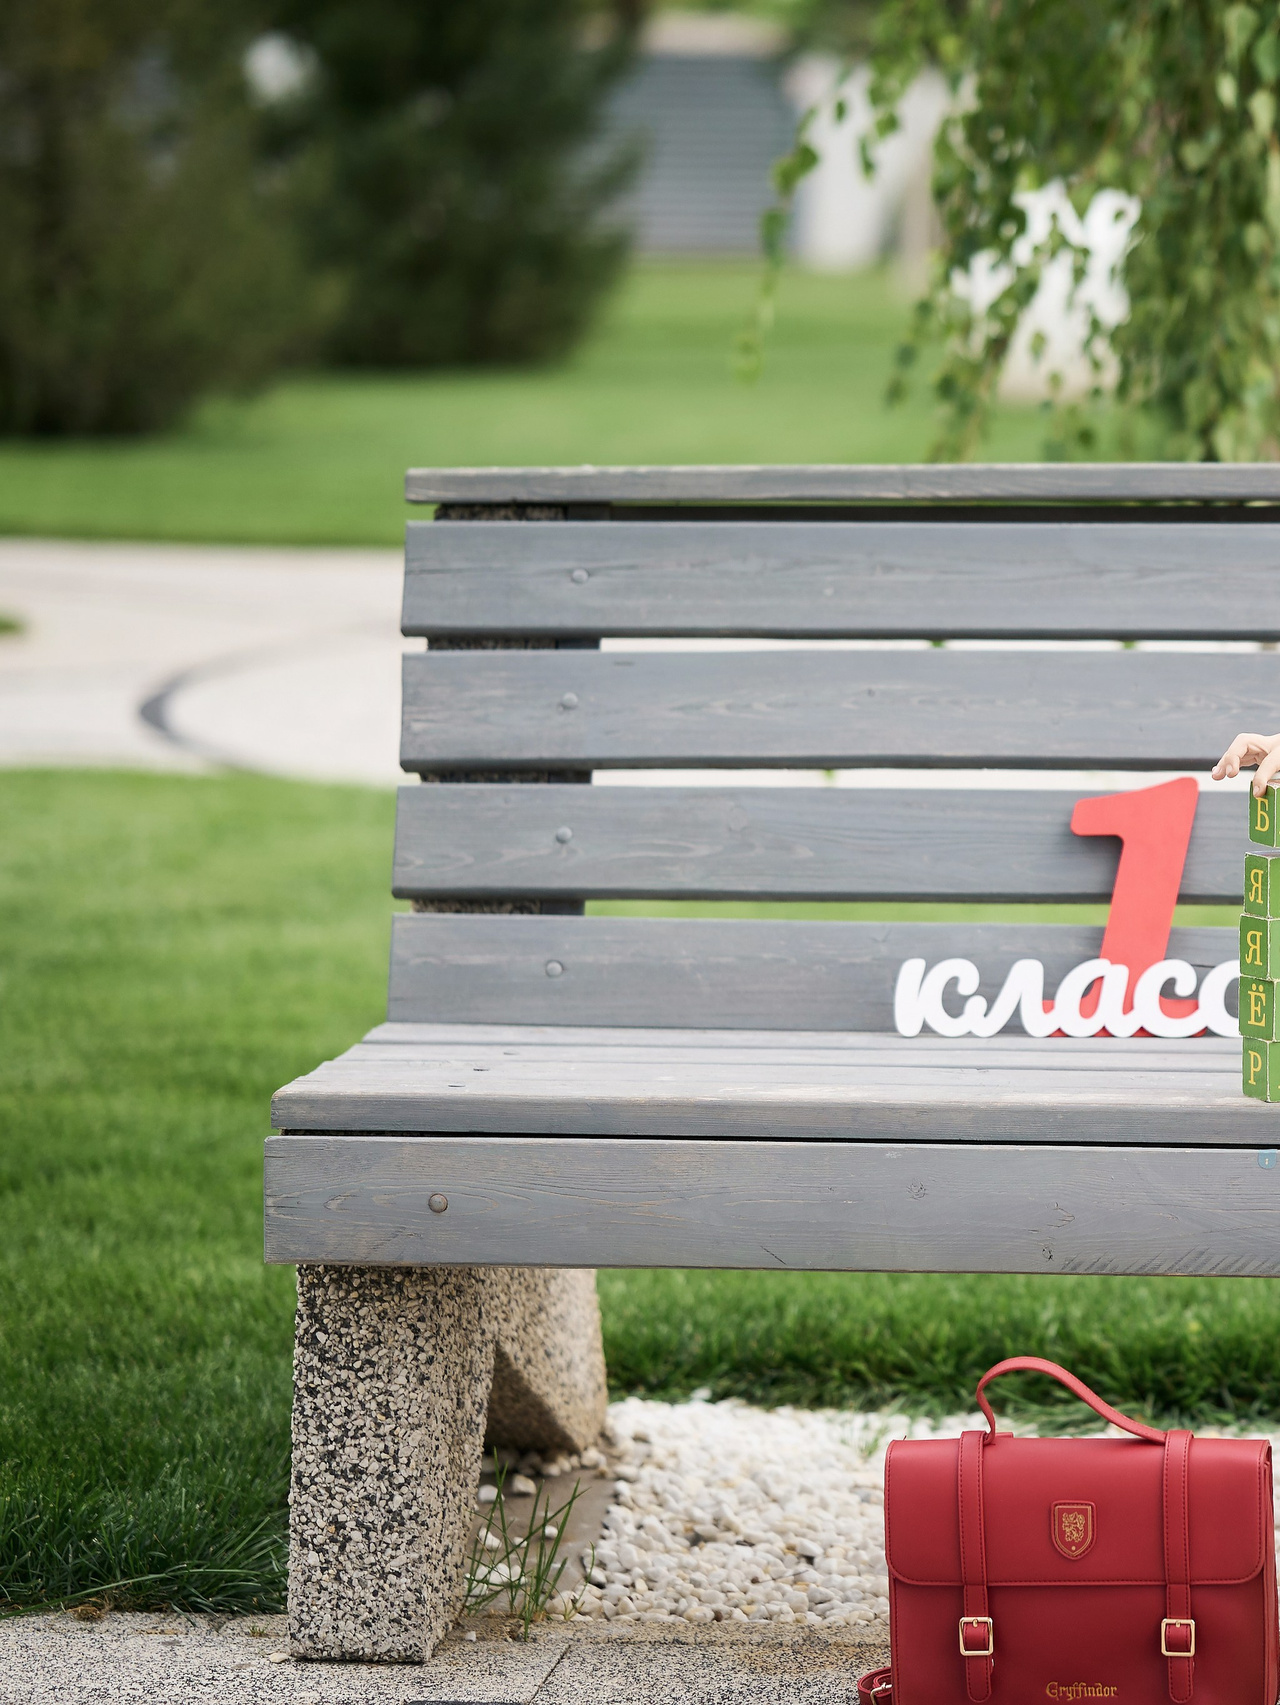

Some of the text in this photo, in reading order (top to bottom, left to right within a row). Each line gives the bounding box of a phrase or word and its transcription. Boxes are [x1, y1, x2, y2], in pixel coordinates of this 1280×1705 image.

[1255, 797, 1270, 832] Б
[1248, 868, 1264, 904] Я
[1043, 777, 1207, 1037] 1
[1245, 930, 1263, 966] Я
[1247, 983, 1266, 1027] Ё
[1248, 1050, 1262, 1085] Р
[1045, 1680, 1118, 1701] Gryffindor
